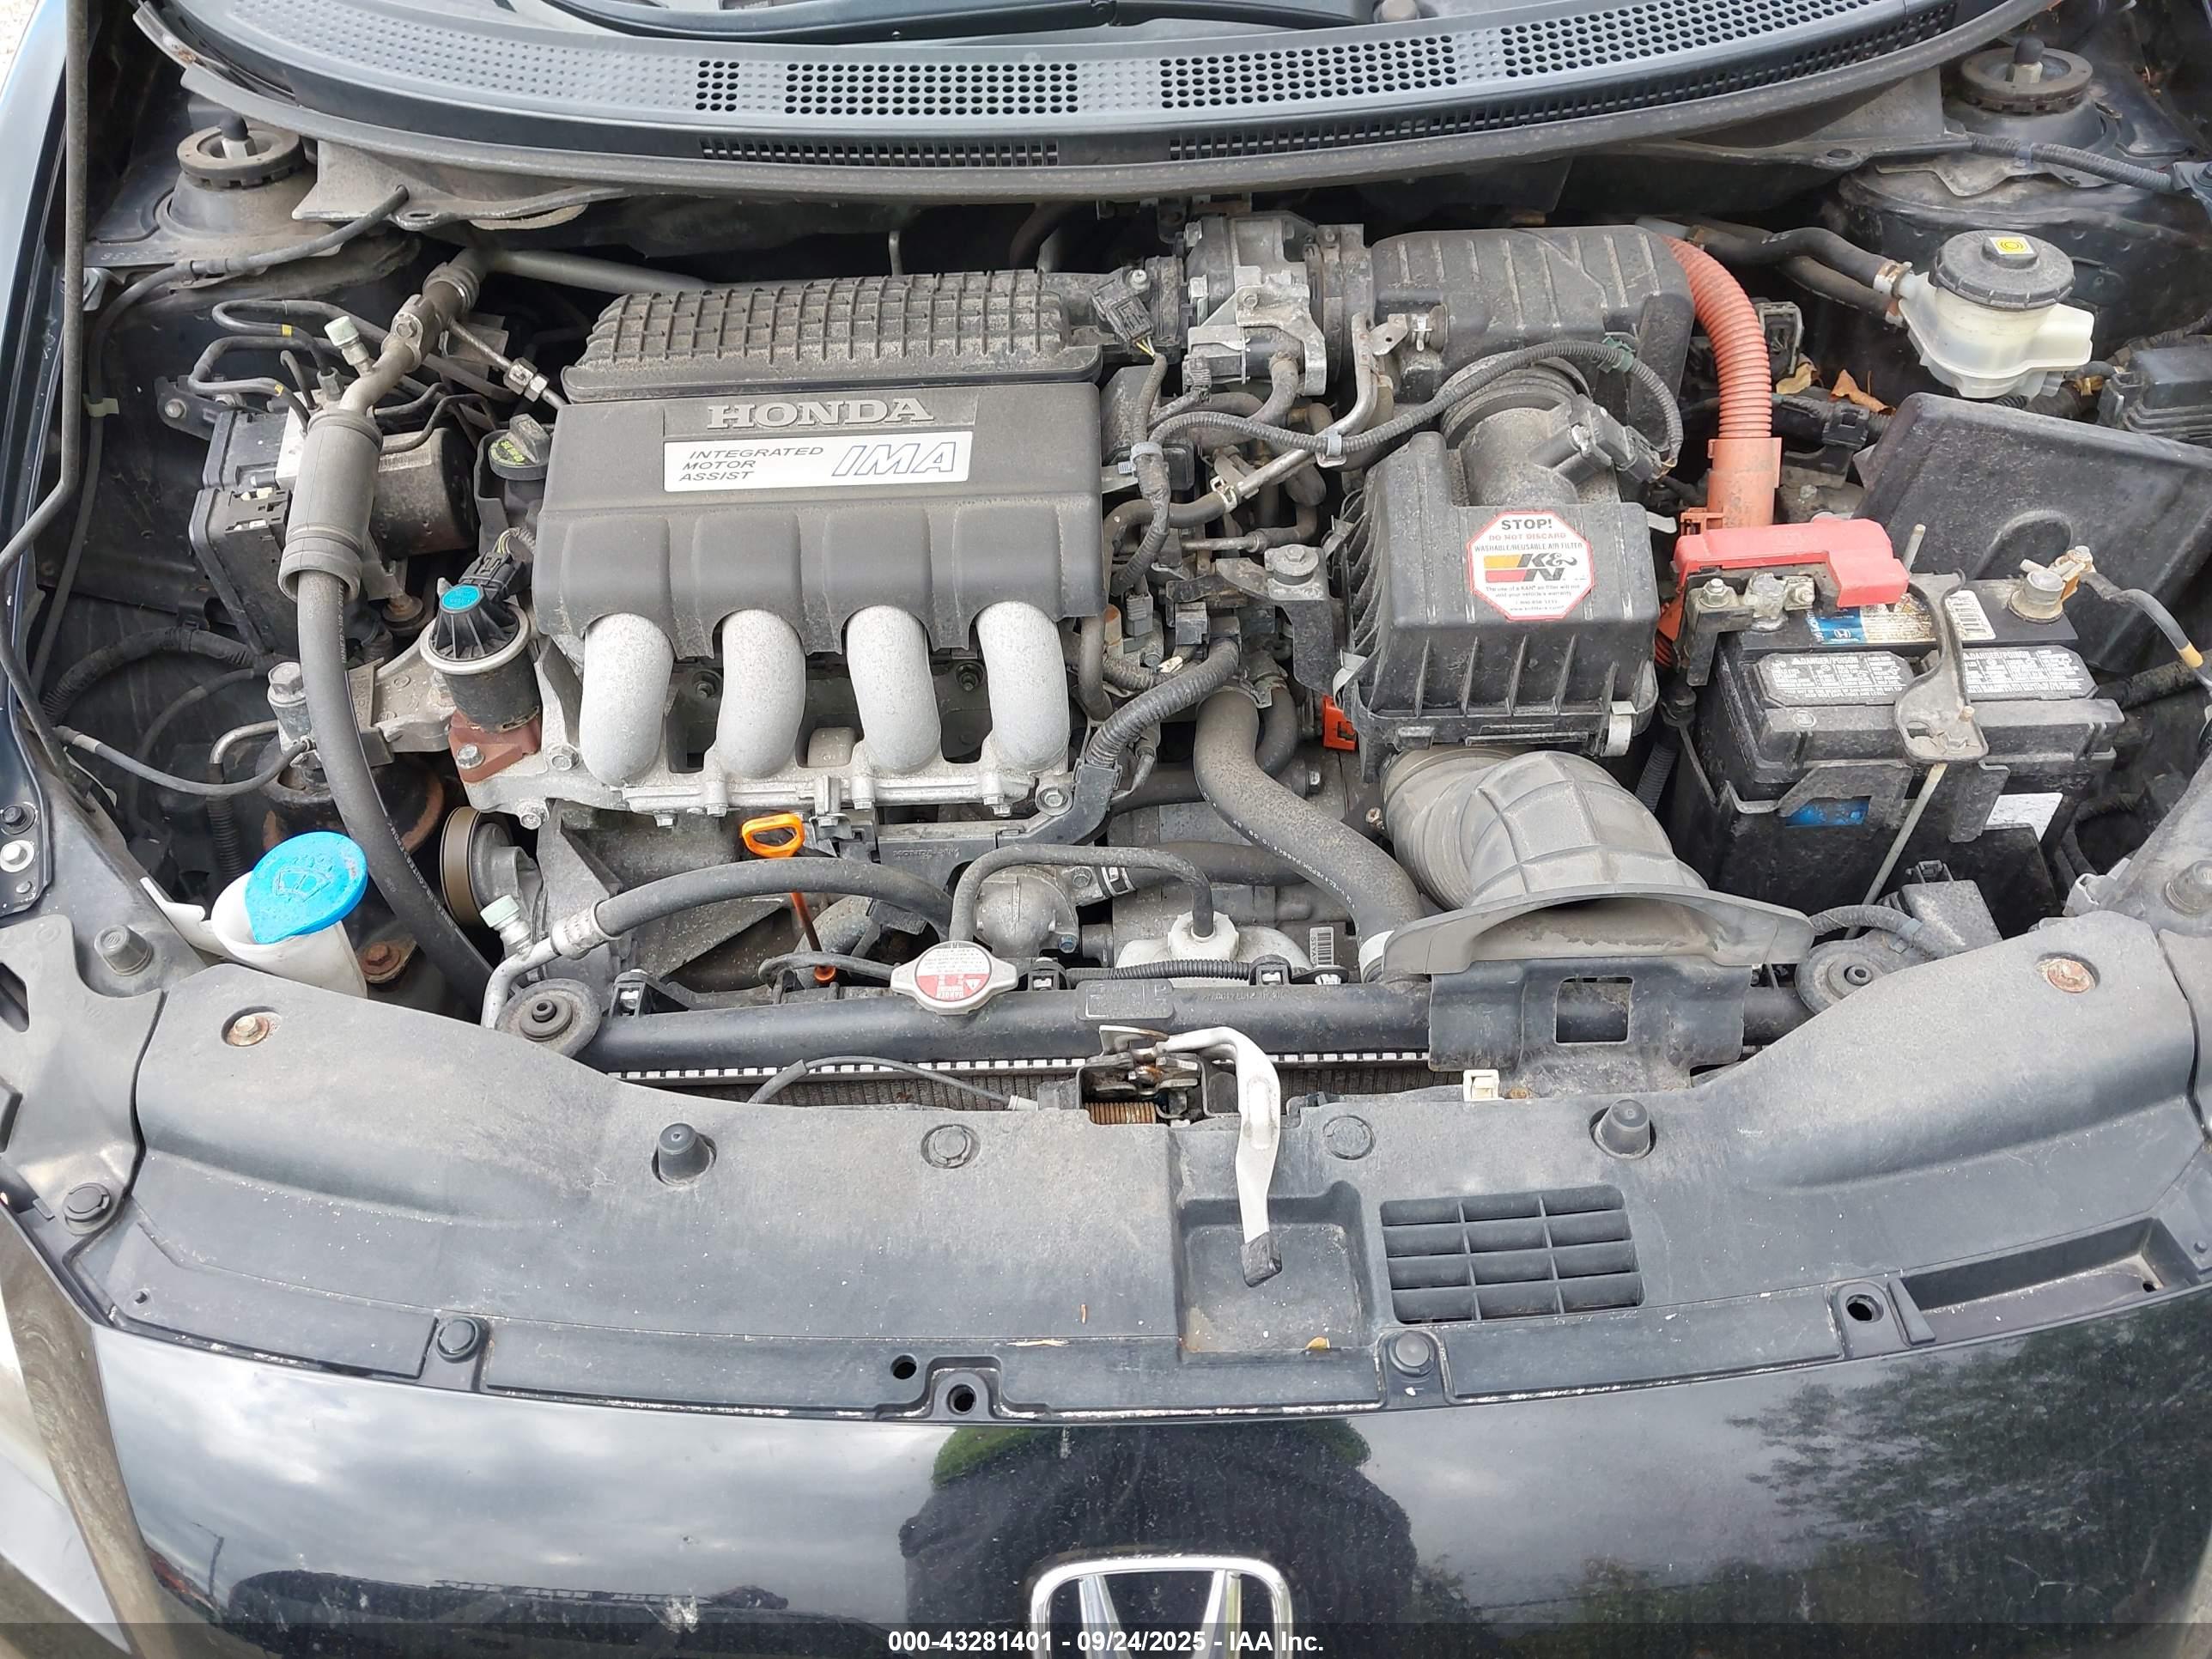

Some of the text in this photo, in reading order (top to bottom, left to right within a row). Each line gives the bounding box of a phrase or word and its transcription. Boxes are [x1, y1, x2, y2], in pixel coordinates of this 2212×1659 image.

[707, 397, 933, 429] HONDA
[688, 446, 824, 460] INTEGRATED
[831, 441, 957, 477] IMA
[683, 459, 757, 471] MOTOR
[678, 470, 755, 483] ASSIST
[1501, 518, 1553, 531] STOP!
[1800, 656, 1859, 665] DANGER/POISON
